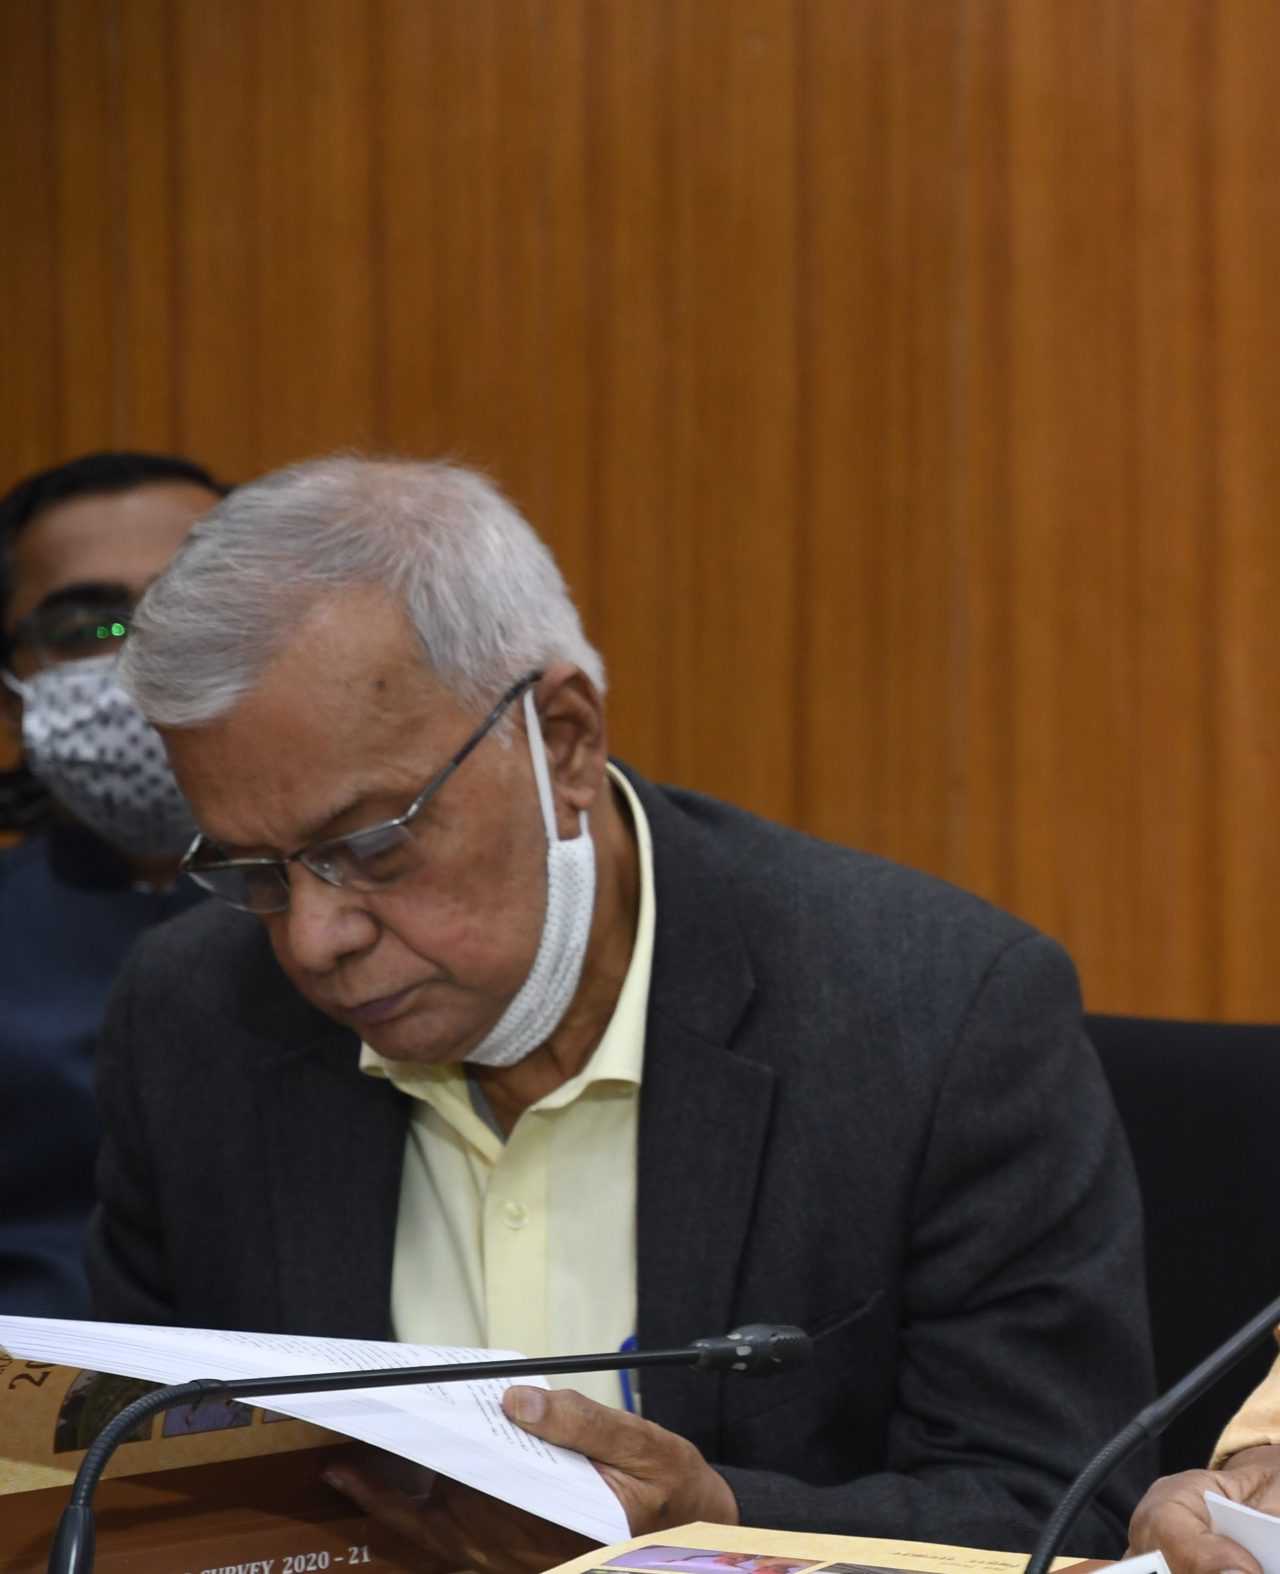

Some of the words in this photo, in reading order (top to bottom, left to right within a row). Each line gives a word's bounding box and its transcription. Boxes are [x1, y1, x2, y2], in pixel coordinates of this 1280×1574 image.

[200, 1560, 275, 1574] RVEY
[282, 1551, 329, 1574] 2020
[348, 1545, 371, 1564] 21
